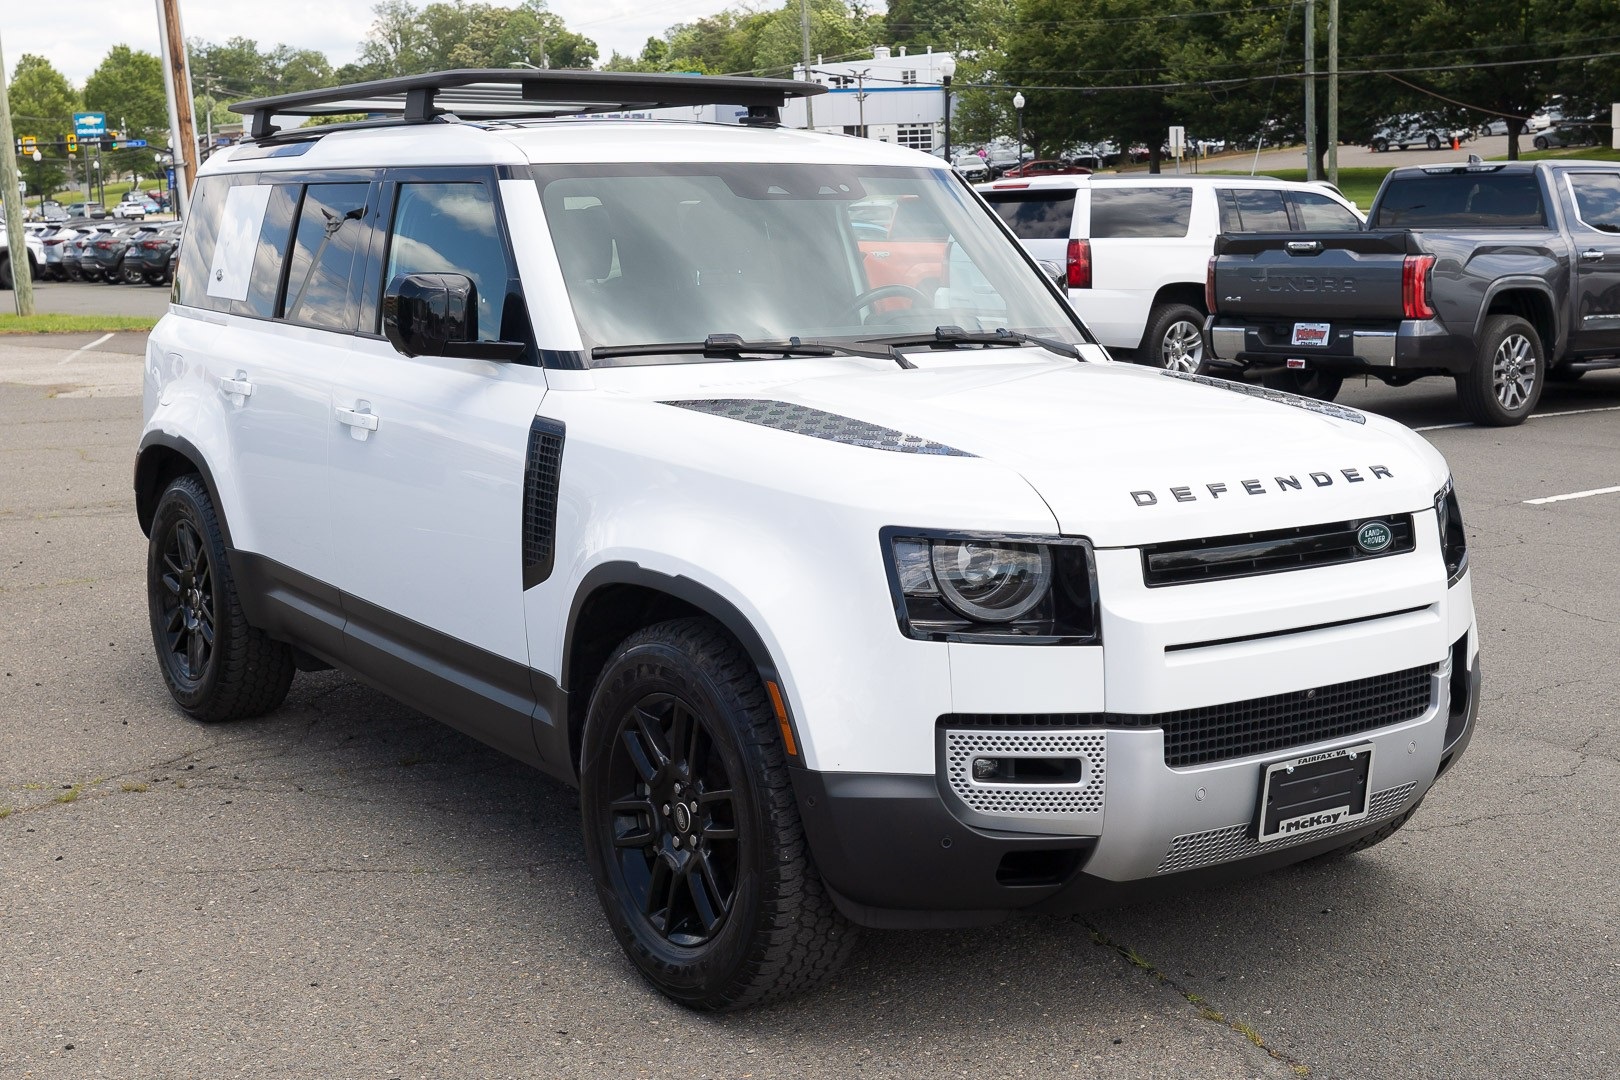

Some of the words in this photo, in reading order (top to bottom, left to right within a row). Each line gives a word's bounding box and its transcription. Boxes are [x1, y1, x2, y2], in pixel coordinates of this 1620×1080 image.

[1249, 275, 1357, 292] TUNDRA
[1130, 464, 1394, 507] DEFENDER
[1286, 812, 1342, 833] McKay
